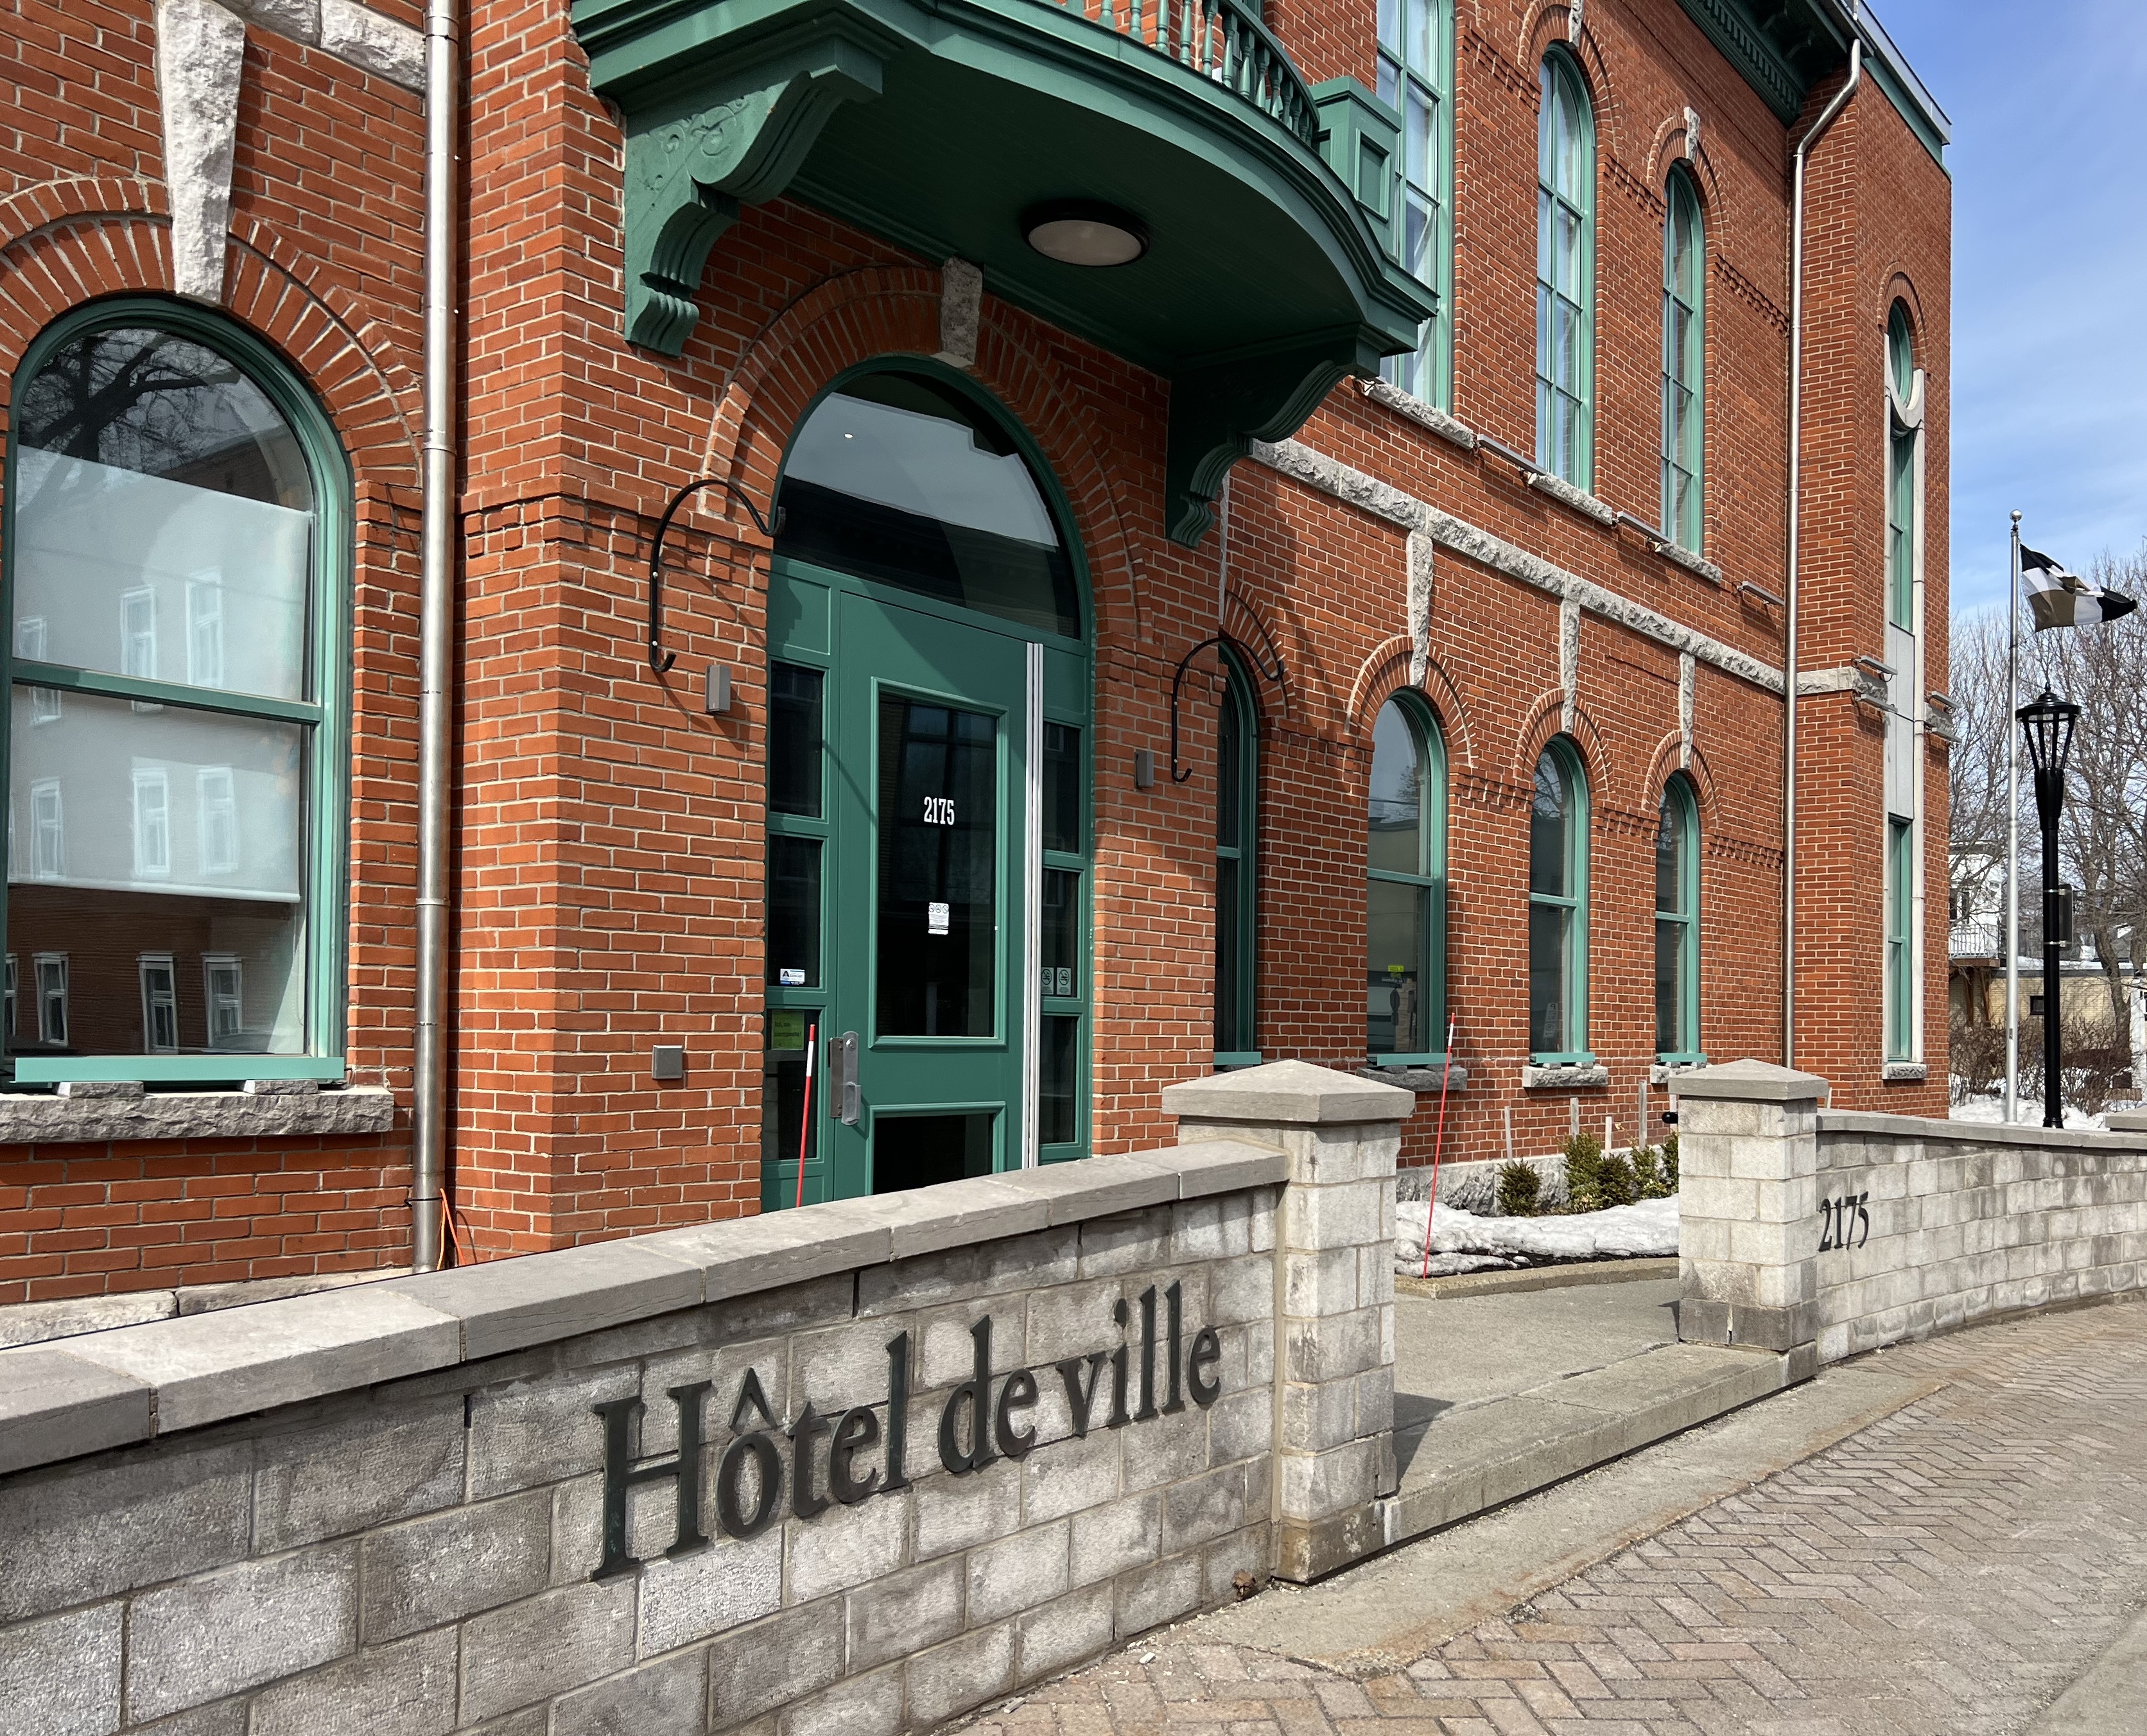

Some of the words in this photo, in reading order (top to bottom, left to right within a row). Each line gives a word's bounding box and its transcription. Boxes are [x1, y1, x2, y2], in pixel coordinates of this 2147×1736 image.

[924, 796, 955, 825] 2175
[1818, 1191, 1869, 1253] 2175
[591, 1330, 910, 1582] Hôtel
[937, 1314, 1037, 1473] de
[1056, 1280, 1221, 1438] ville
